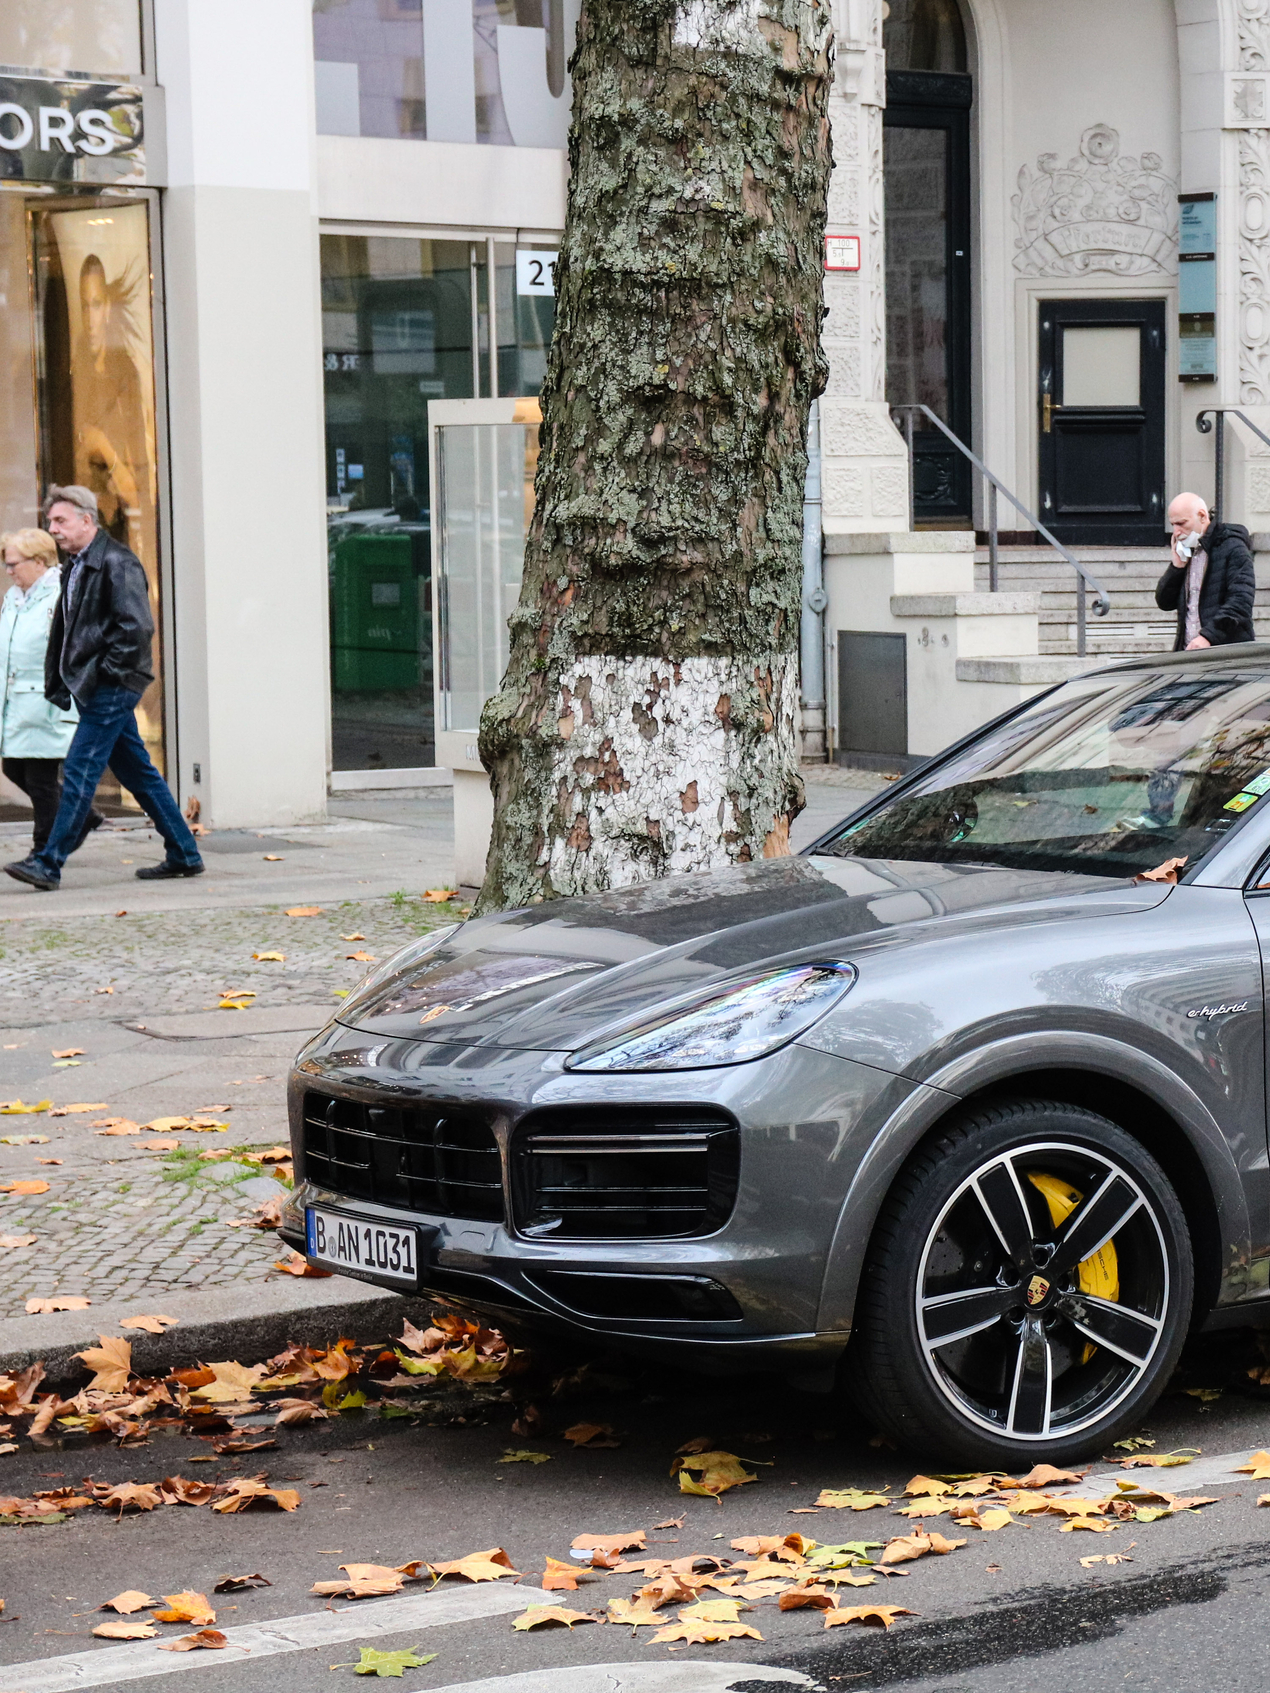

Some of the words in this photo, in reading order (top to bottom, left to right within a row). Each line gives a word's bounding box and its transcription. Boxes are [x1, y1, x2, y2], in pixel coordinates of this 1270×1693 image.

[1187, 1001, 1248, 1021] e-hybrid
[316, 1215, 326, 1254] B
[338, 1221, 360, 1263] AN
[363, 1227, 415, 1275] 1031
